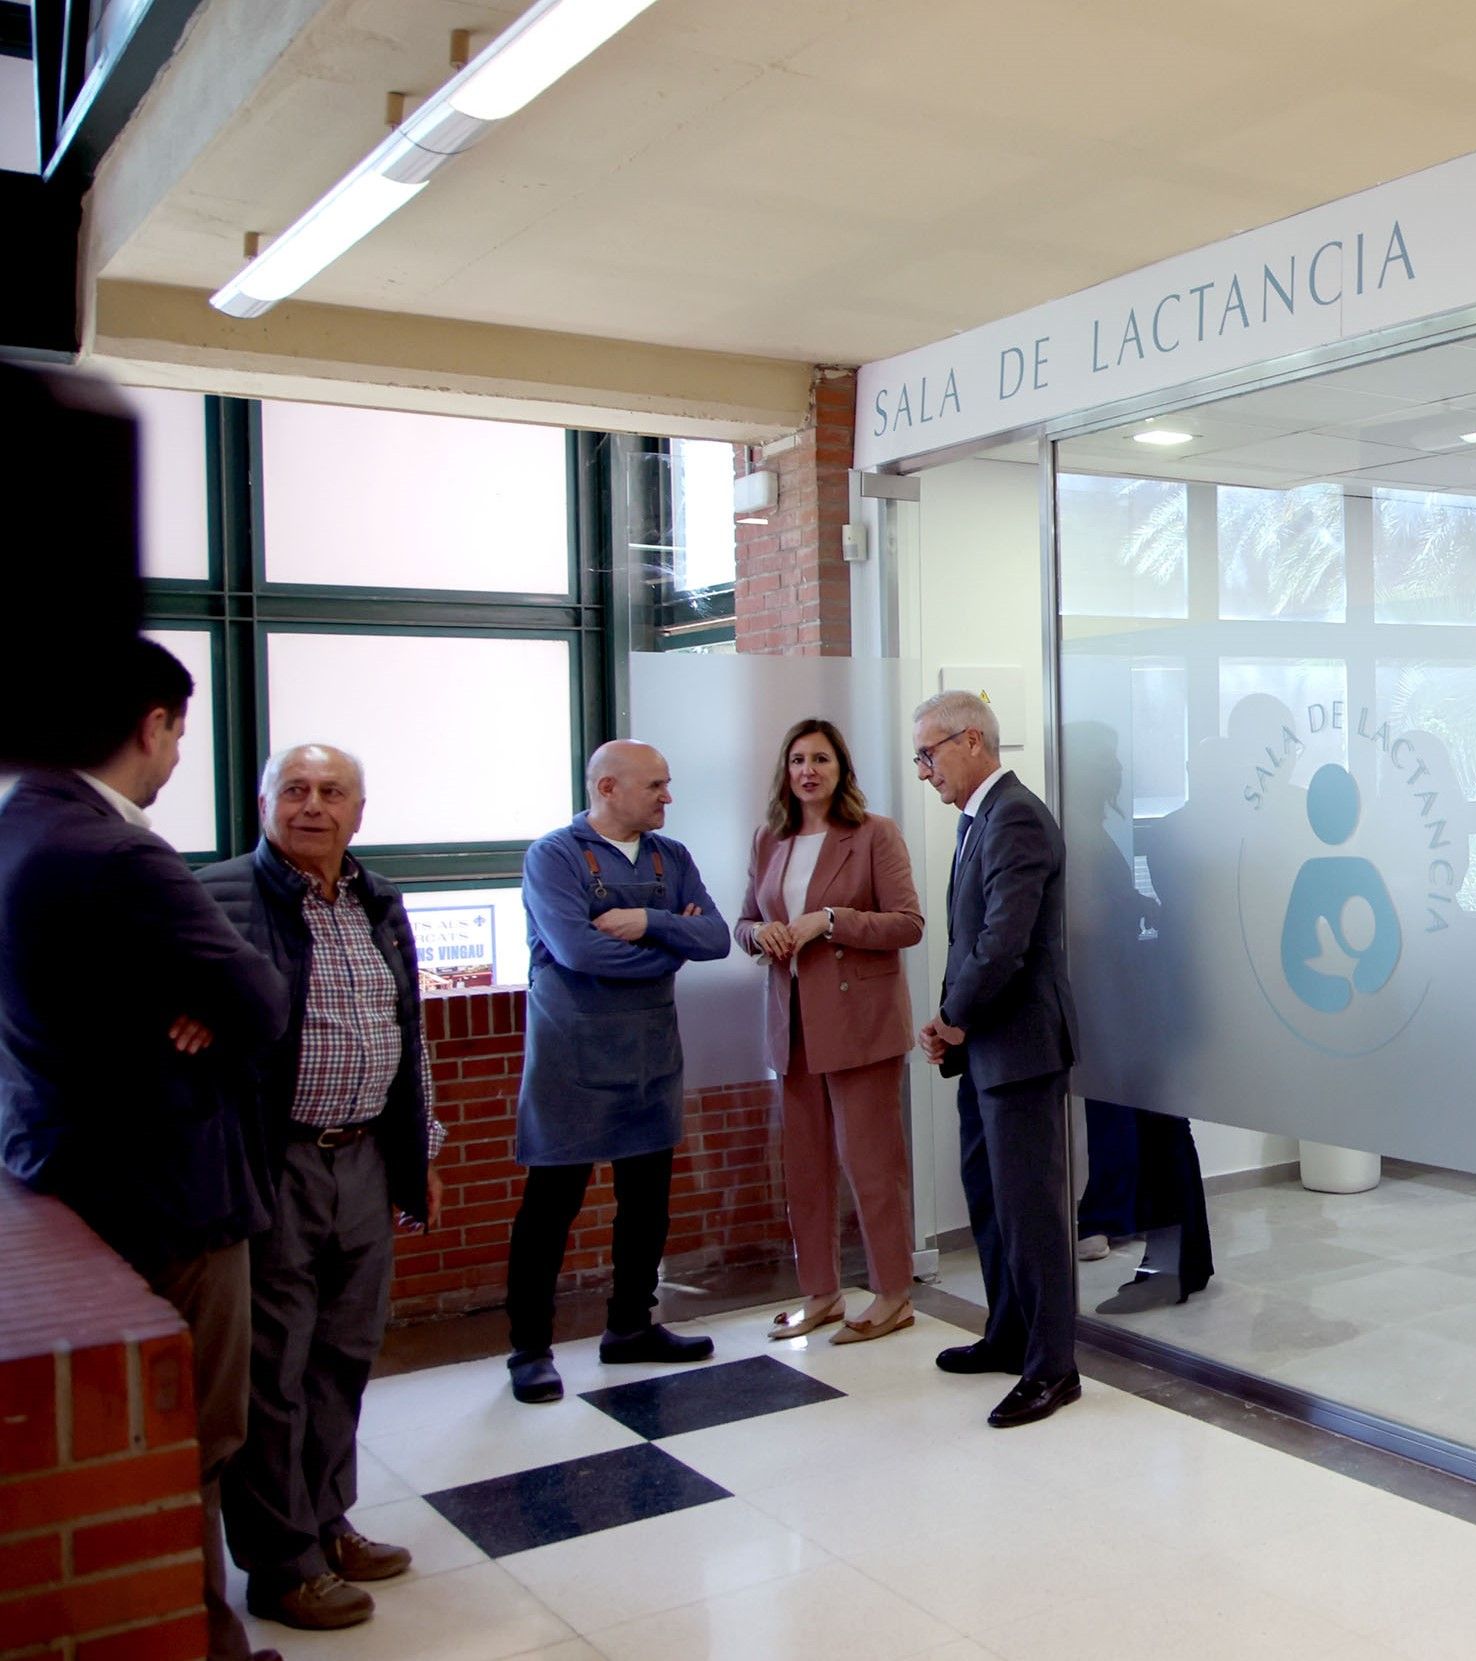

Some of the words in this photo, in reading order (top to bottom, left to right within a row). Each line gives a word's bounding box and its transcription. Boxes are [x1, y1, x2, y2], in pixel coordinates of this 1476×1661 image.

[873, 367, 962, 438] SALA
[999, 336, 1050, 400] DE
[1091, 219, 1416, 373] LACTANCIA
[1243, 725, 1304, 810] SALA
[1307, 700, 1344, 733] DE
[1357, 706, 1454, 934] LACTANCIA
[415, 931, 470, 943] RCATS
[416, 946, 434, 962] NS
[438, 944, 485, 961] VINGAU
